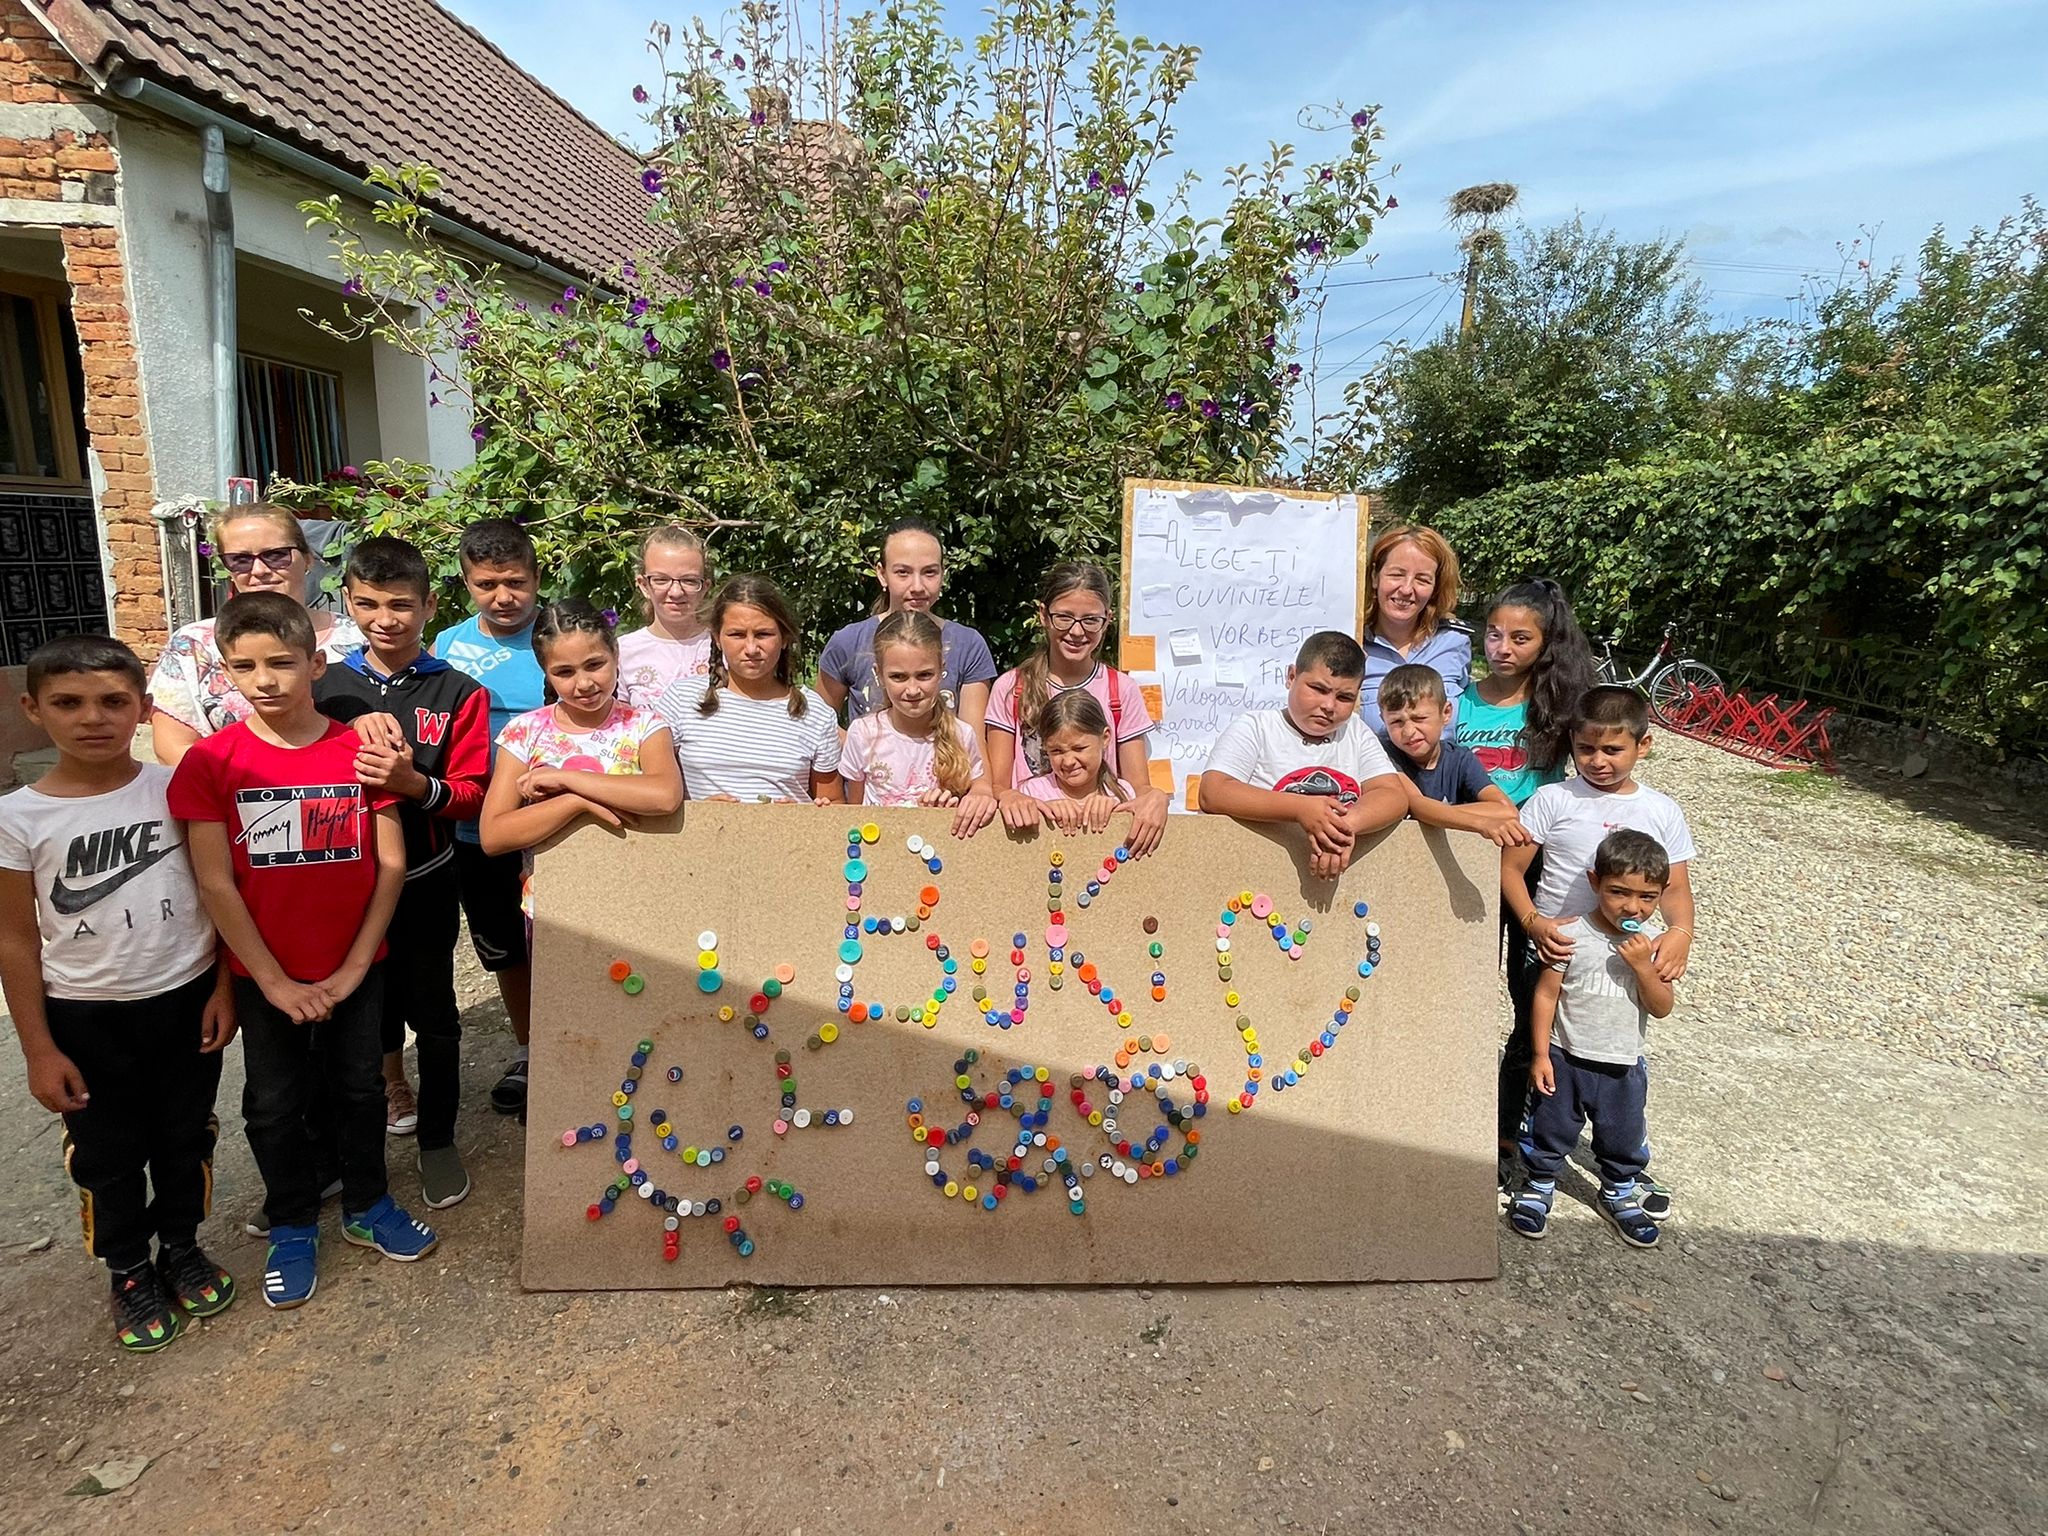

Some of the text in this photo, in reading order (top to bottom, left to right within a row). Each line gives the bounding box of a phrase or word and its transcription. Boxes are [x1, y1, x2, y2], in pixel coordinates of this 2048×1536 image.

[414, 706, 451, 746] W
[238, 786, 358, 802] TOMMY
[65, 820, 163, 878] NIKE
[73, 898, 175, 939] AIR
